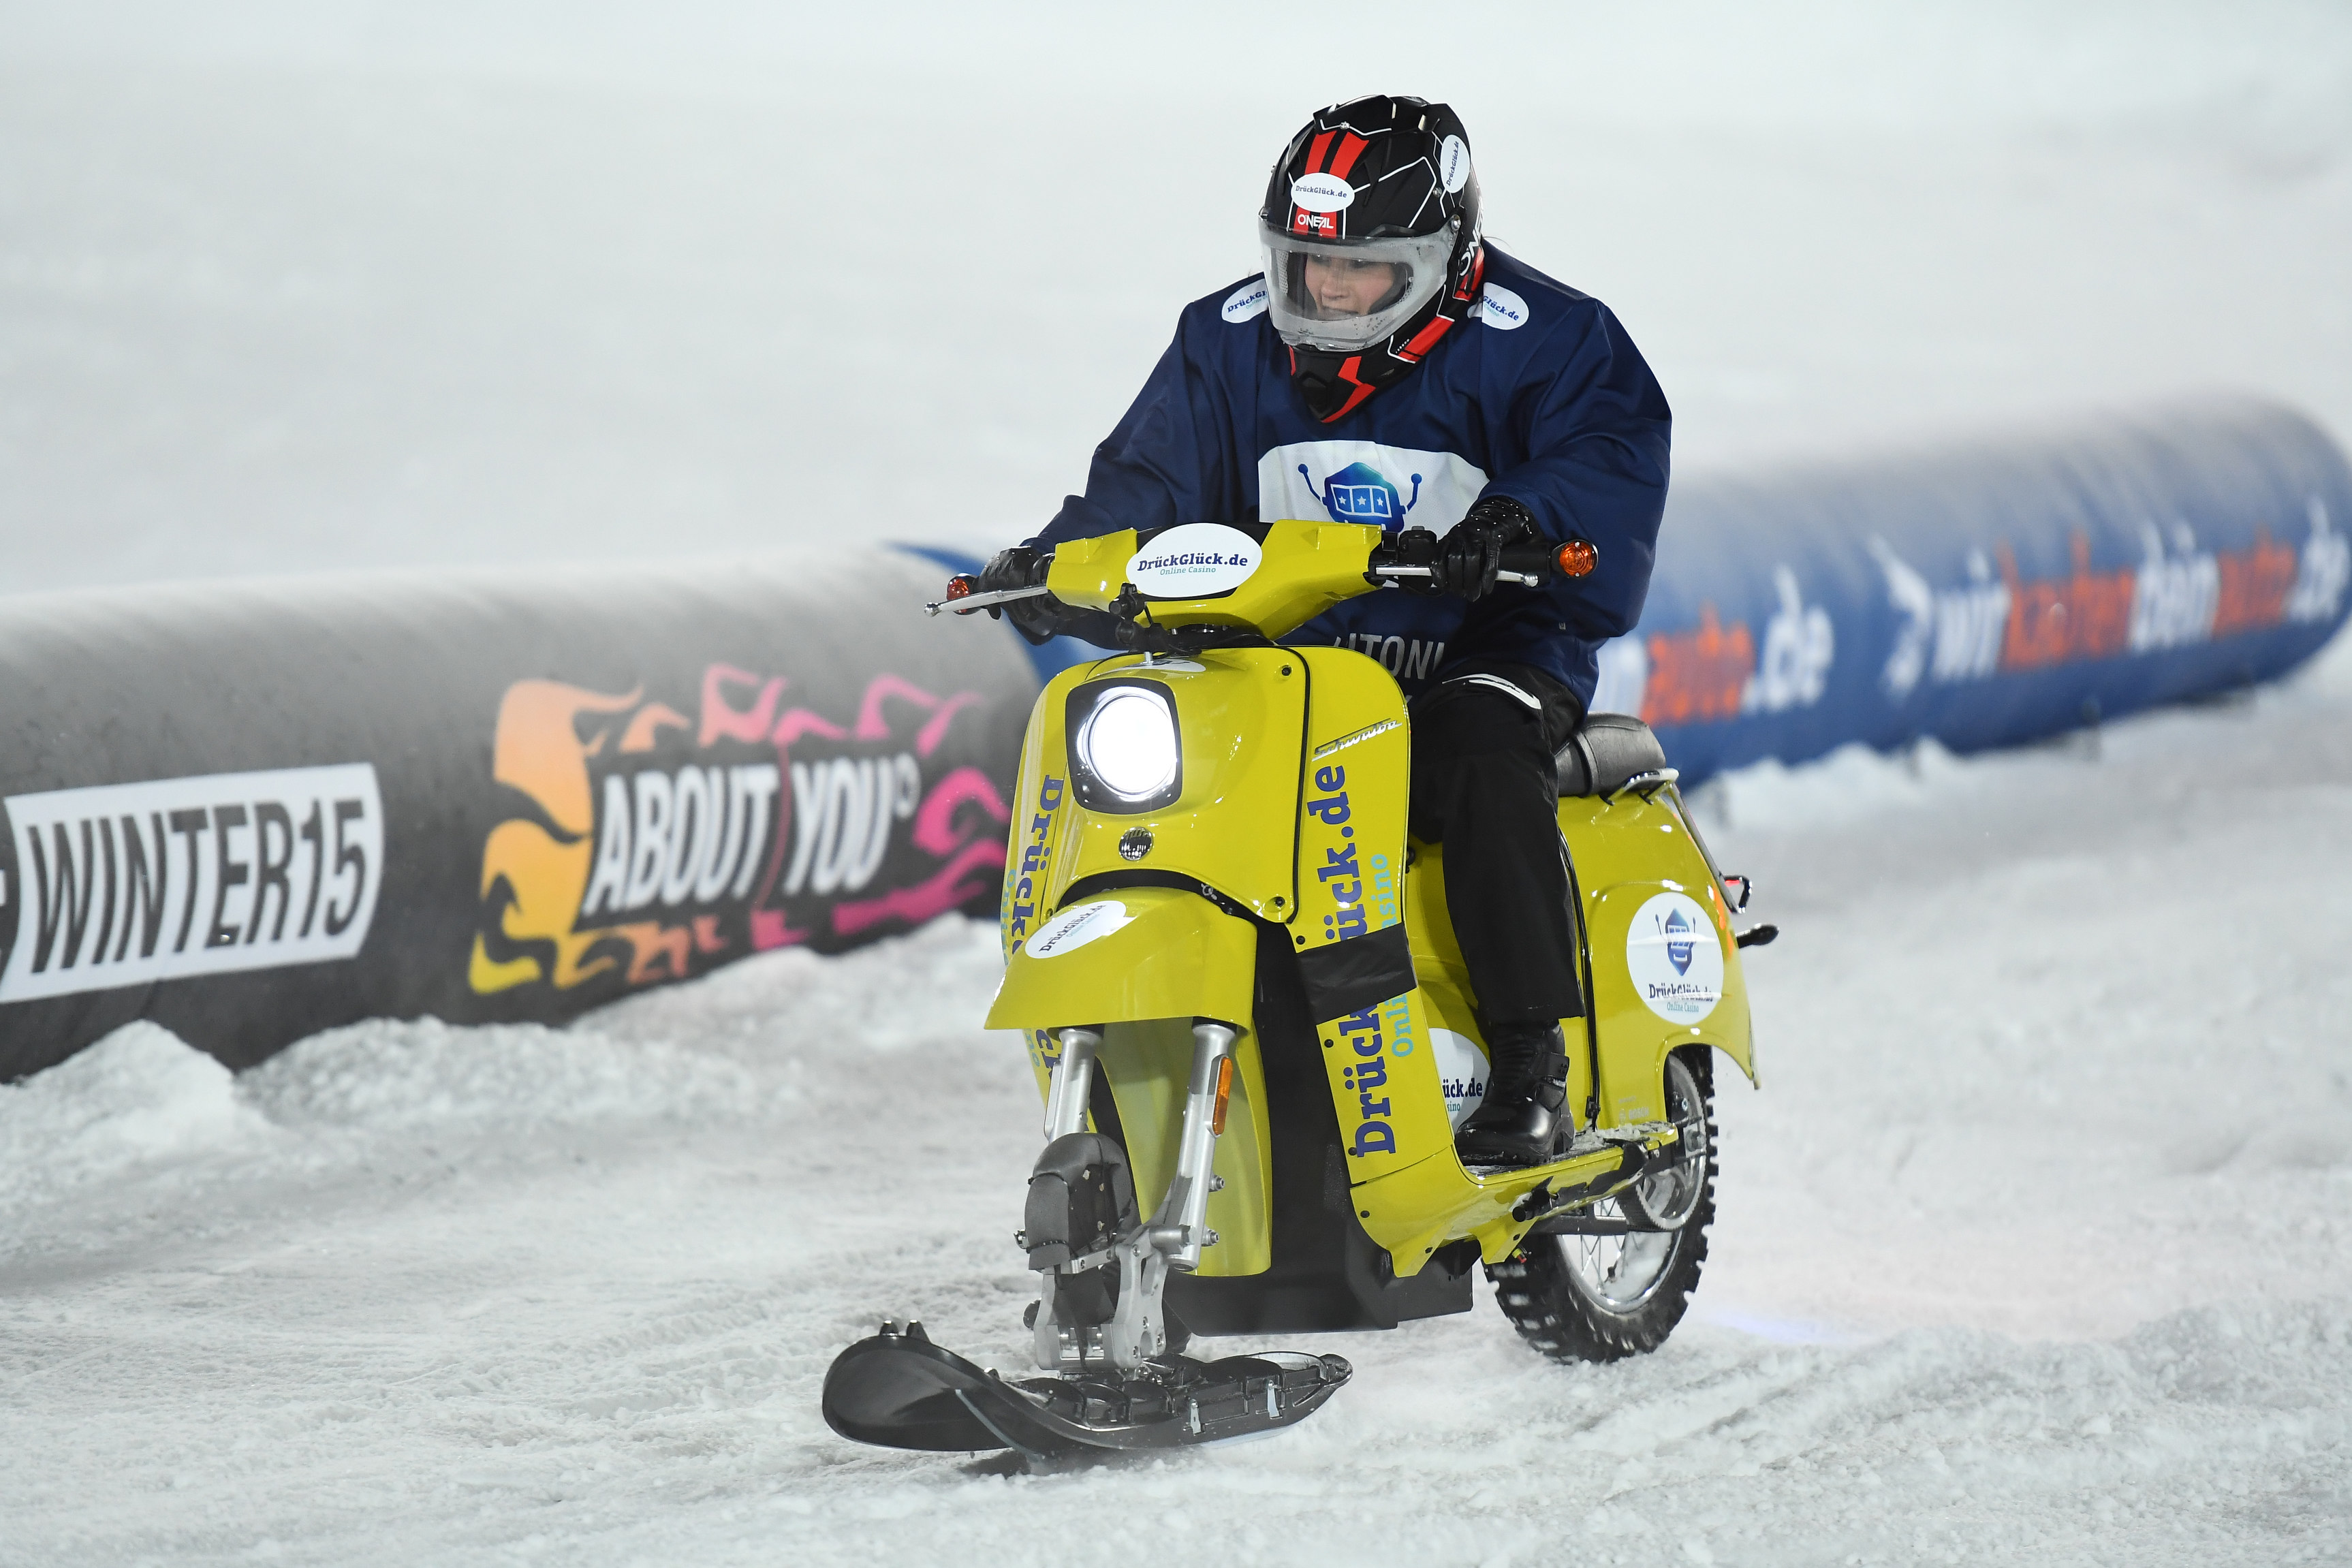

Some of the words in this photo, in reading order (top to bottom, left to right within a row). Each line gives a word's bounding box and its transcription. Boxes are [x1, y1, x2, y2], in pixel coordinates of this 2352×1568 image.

[1446, 140, 1459, 187] DrückGlück.de
[1295, 185, 1347, 198] DrückGlück.de
[1227, 291, 1268, 313] DrückGl
[1137, 552, 1248, 571] DrückGlück.de
[1160, 567, 1187, 575] Online
[580, 762, 780, 917] ABOUT
[27, 798, 366, 975] WINTER15
[1384, 993, 1414, 1057] Onli
[1443, 1078, 1483, 1098] ück.de
[1447, 1101, 1460, 1112] sino
